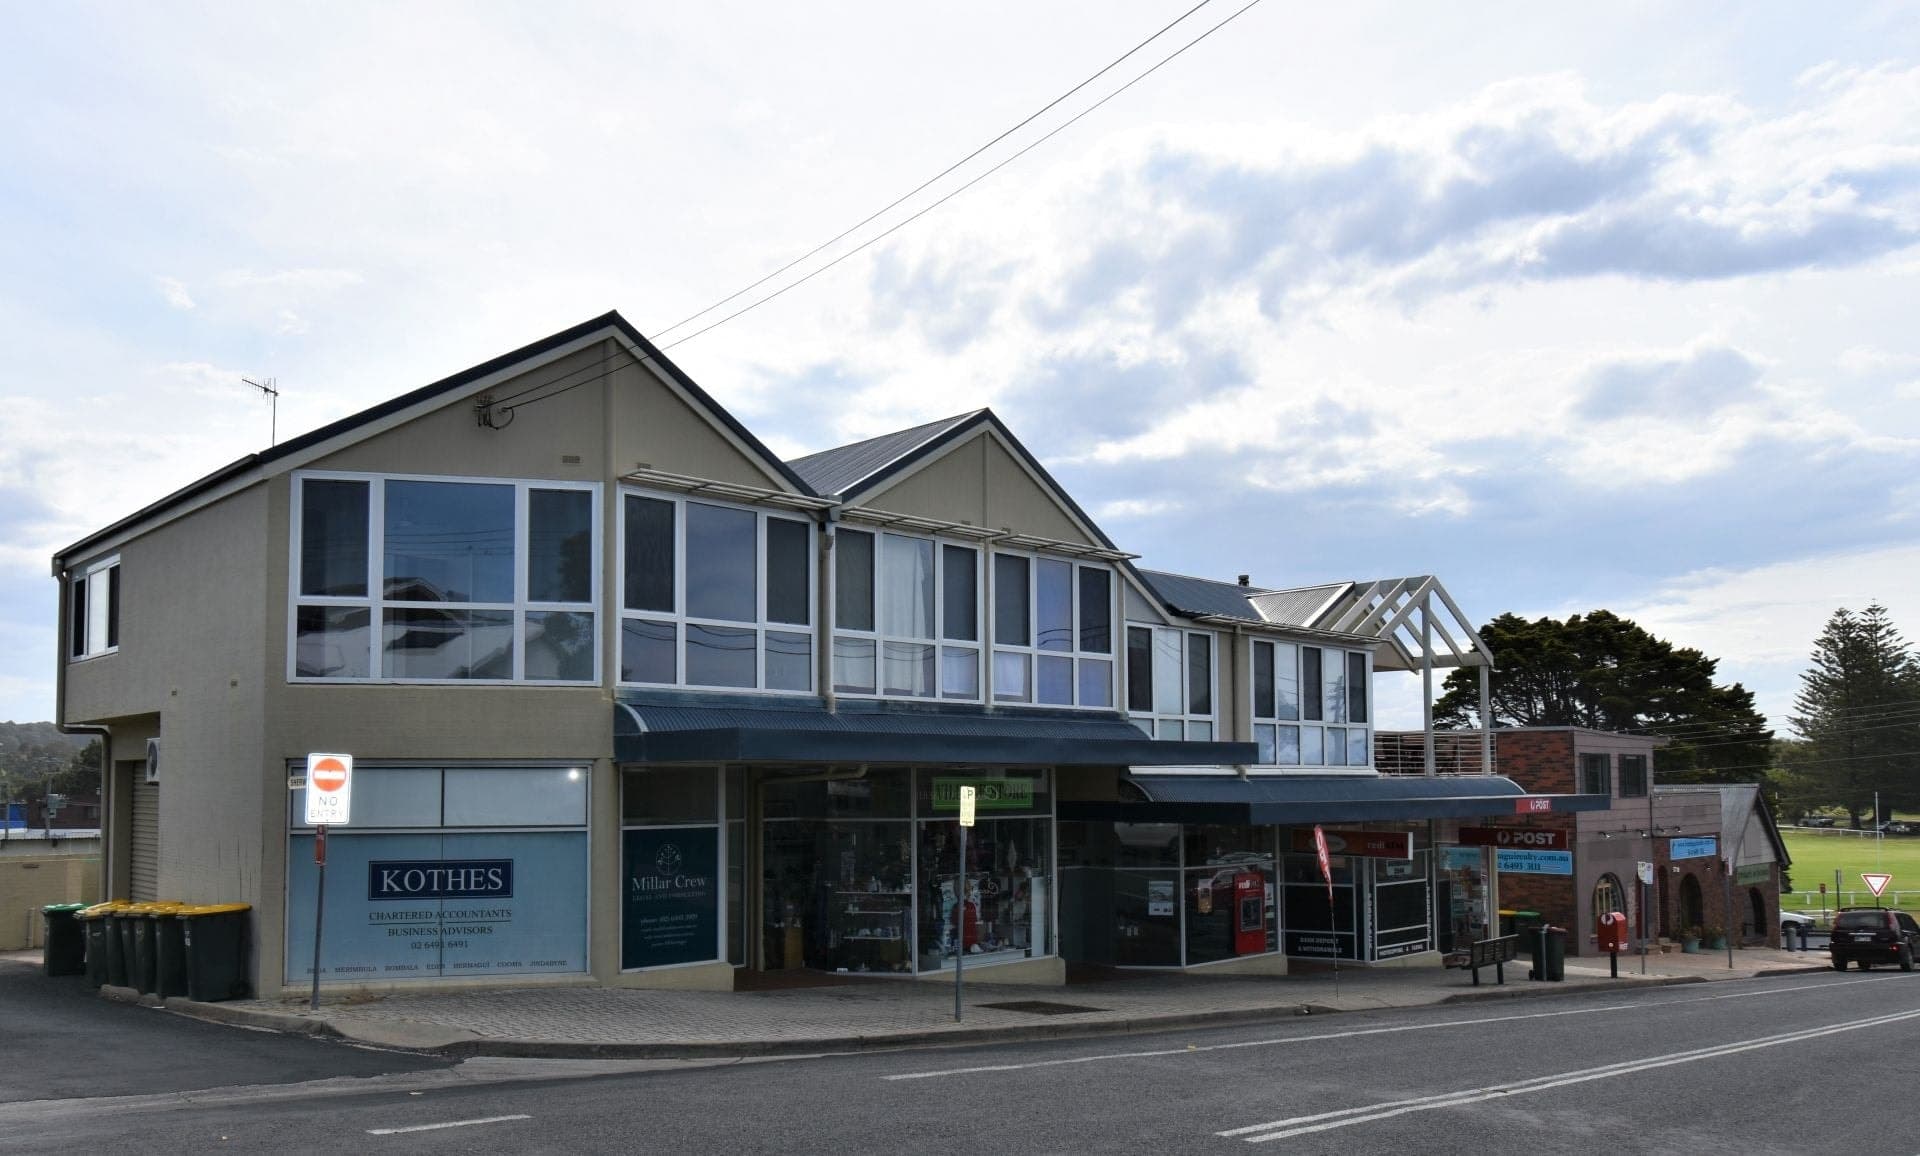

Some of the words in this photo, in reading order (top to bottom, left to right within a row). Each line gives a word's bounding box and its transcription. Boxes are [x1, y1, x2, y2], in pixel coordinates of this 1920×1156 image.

[318, 796, 338, 807] NO
[1535, 800, 1550, 810] POST
[310, 809, 344, 818] ENTRY
[1513, 832, 1556, 845] POST
[380, 868, 504, 893] KOTHES
[632, 876, 672, 891] Millar
[675, 873, 706, 889] Crew
[369, 911, 433, 922] CHARTERED
[436, 908, 512, 920] ACCOUNTANTS
[388, 926, 438, 937] BUSINESS
[440, 924, 493, 936] ADVISORS
[411, 942, 423, 950] 02
[447, 940, 469, 949] 6491
